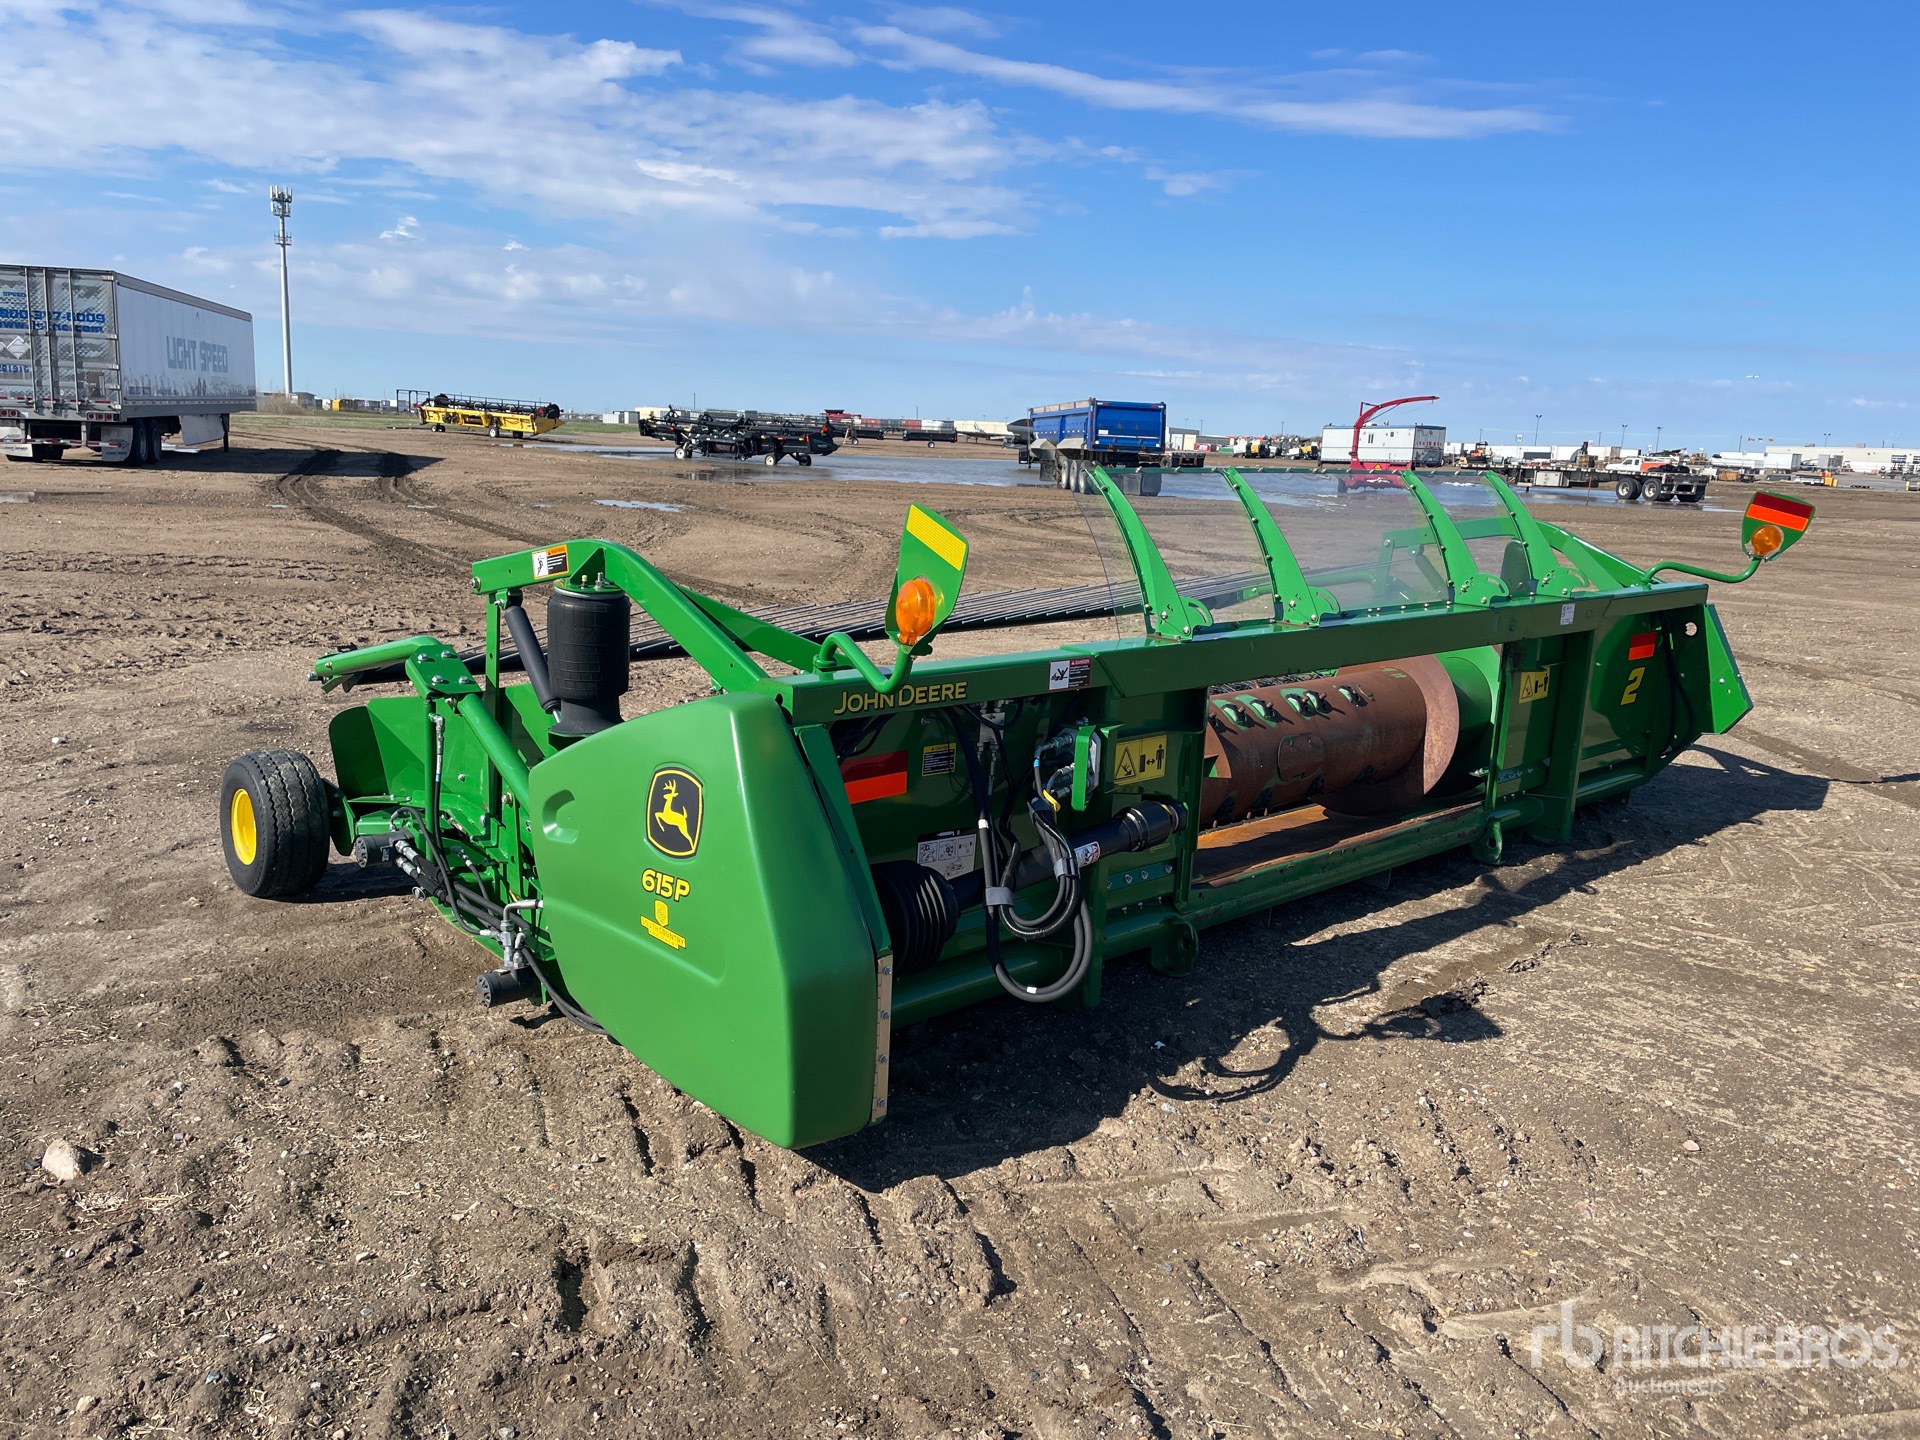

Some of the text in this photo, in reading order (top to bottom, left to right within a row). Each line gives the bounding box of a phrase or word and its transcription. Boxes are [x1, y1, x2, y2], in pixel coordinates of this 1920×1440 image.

[166, 336, 228, 373] LIGHT SPEED
[834, 681, 967, 714] JOHN DEERE
[1620, 667, 1646, 705] 2
[641, 868, 691, 902] 615P
